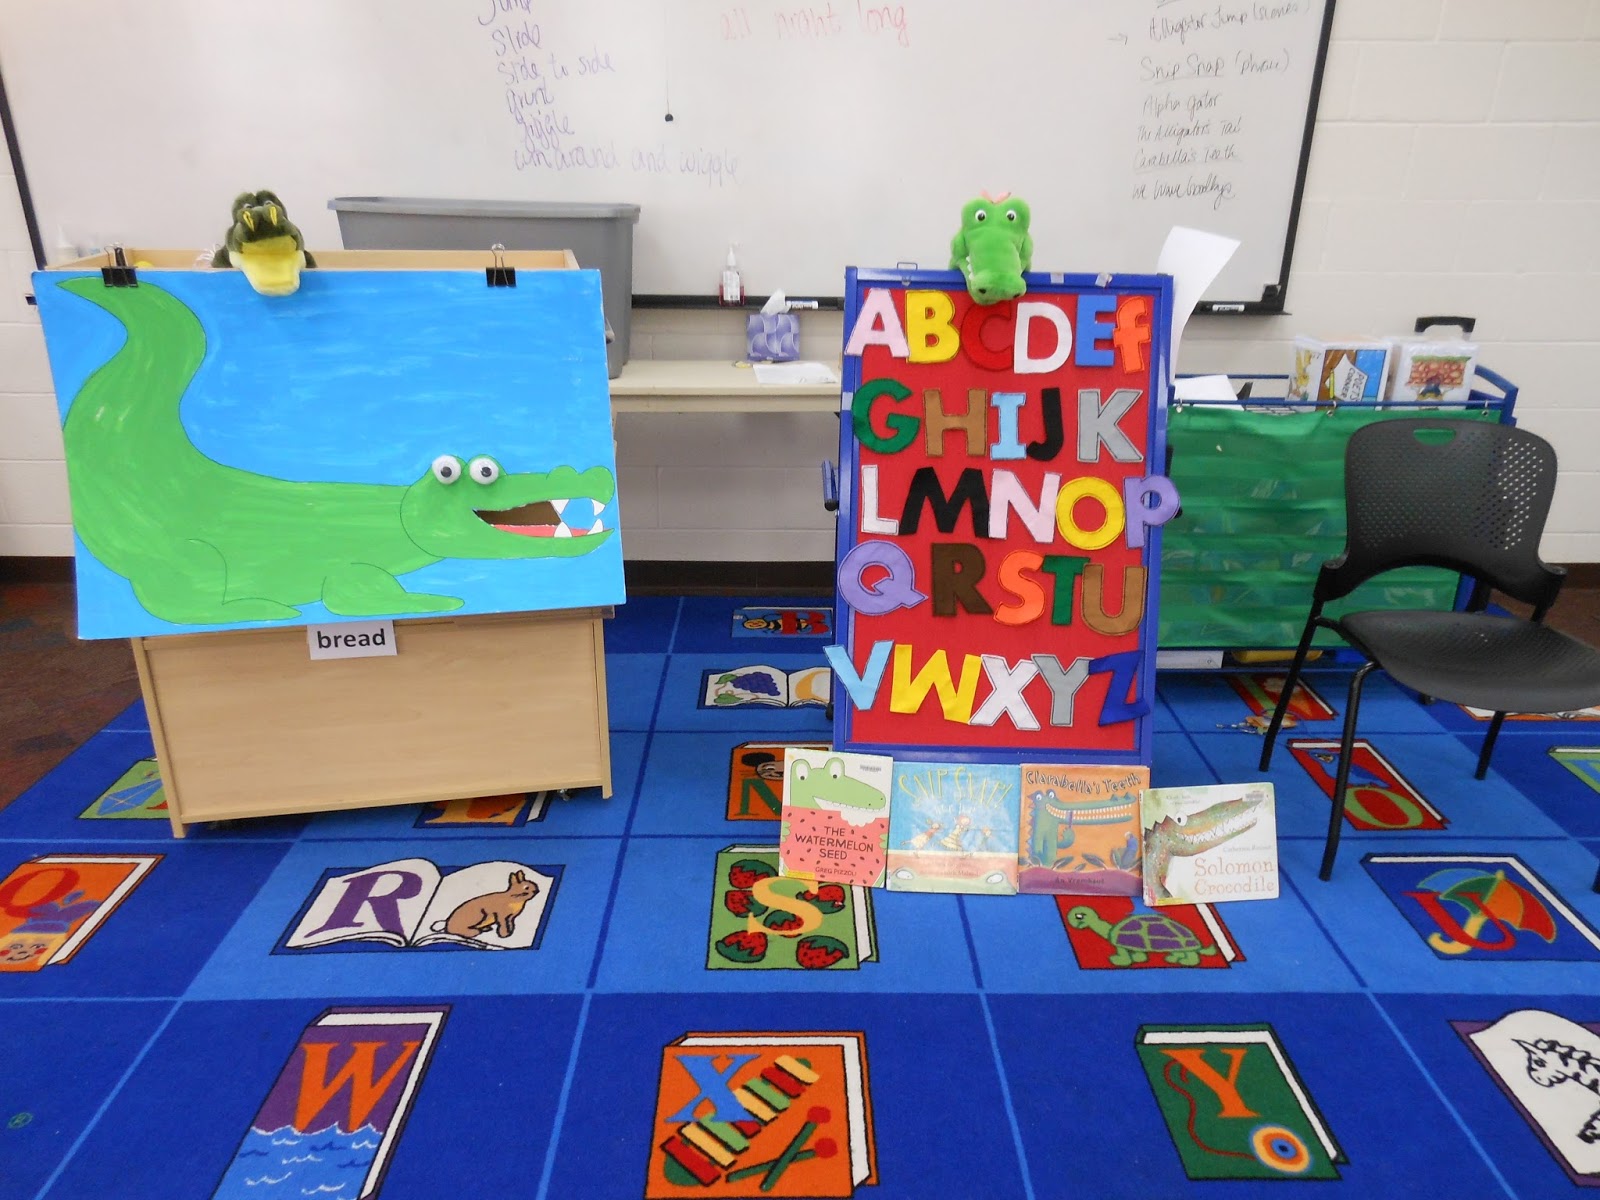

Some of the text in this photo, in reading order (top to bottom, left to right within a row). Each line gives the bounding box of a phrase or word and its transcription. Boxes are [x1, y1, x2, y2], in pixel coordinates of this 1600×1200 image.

[857, 0, 910, 48] long
[1139, 56, 1180, 82] Snip
[1186, 53, 1225, 77] Snap
[316, 628, 386, 649] bread
[1026, 771, 1142, 794] Clarabella's Teeth
[824, 825, 846, 837] THE
[795, 833, 874, 853] WATERMELON
[819, 848, 848, 860] SEED
[814, 866, 832, 875] GREG
[1195, 857, 1275, 878] Solomon
[1194, 876, 1275, 895] Crocodile
[304, 870, 423, 937] R
[747, 876, 824, 936] S
[294, 1040, 421, 1132] W
[664, 1054, 763, 1124] X
[1159, 1048, 1262, 1118] Y
